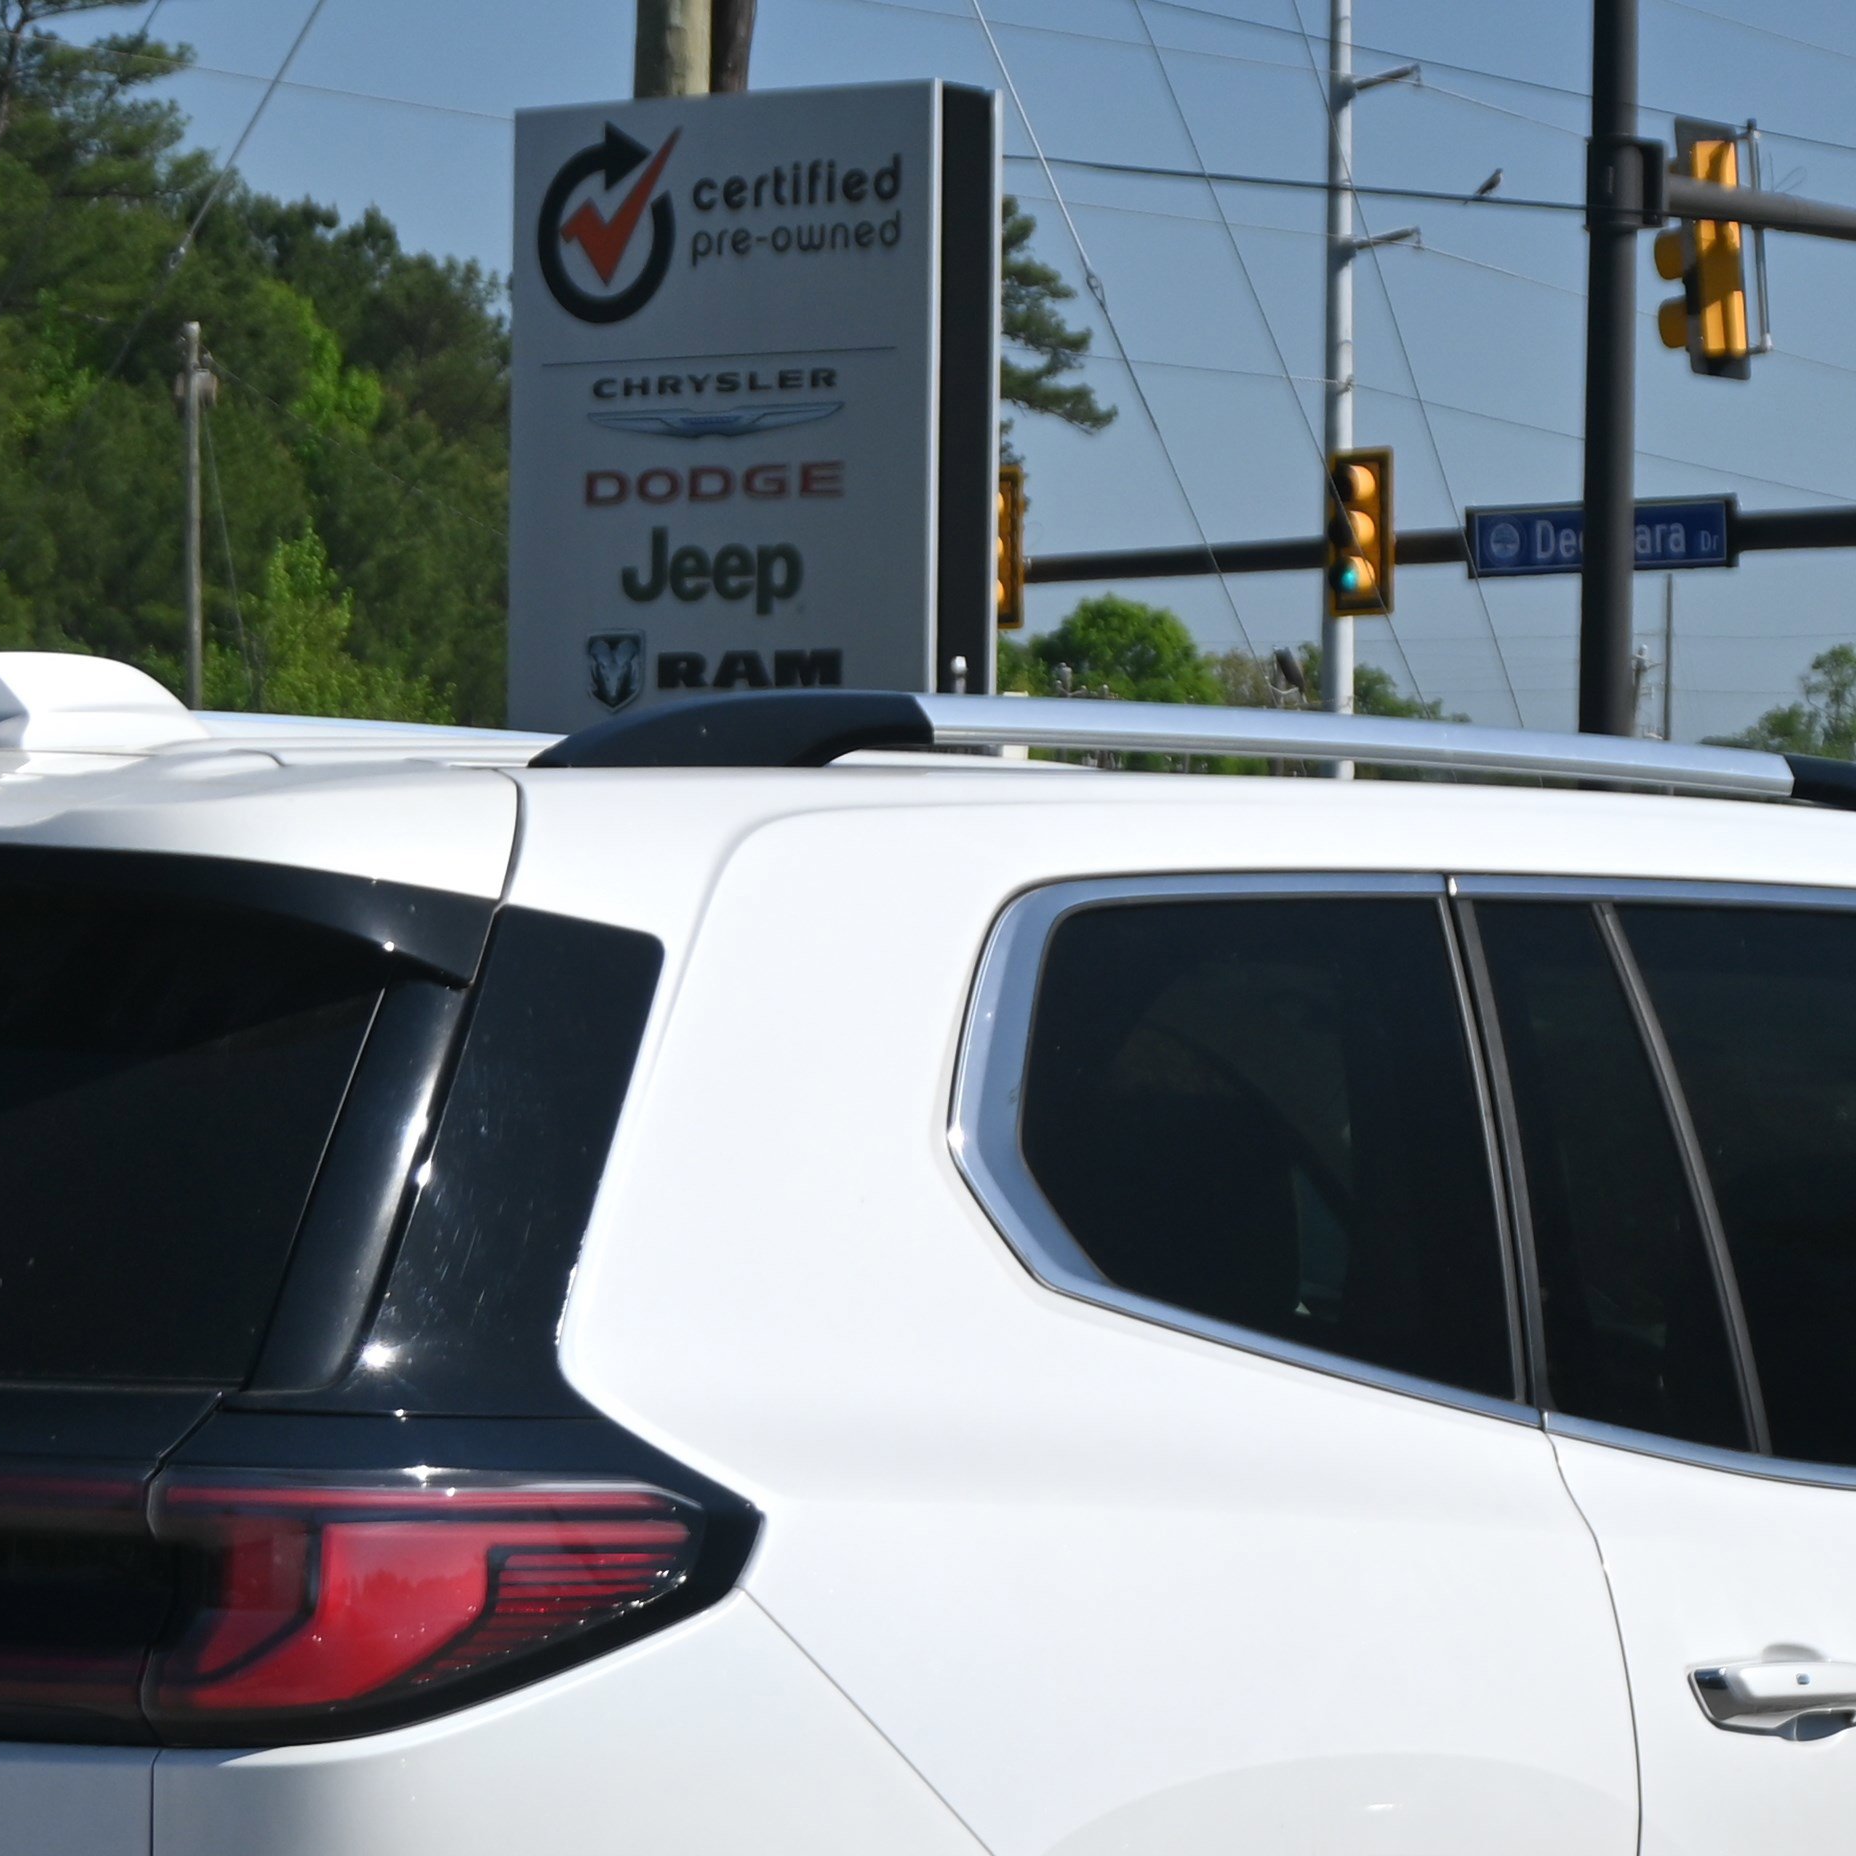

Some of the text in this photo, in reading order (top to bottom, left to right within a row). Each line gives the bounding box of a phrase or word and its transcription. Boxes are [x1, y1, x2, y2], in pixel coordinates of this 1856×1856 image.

[693, 154, 902, 211] certified
[692, 211, 901, 267] pre-owned
[593, 367, 838, 398] CHRYSLER
[584, 460, 845, 506] DODGE
[1535, 518, 1719, 559] Deara Dr
[622, 526, 803, 615] Jeep
[657, 648, 843, 688] RAM
